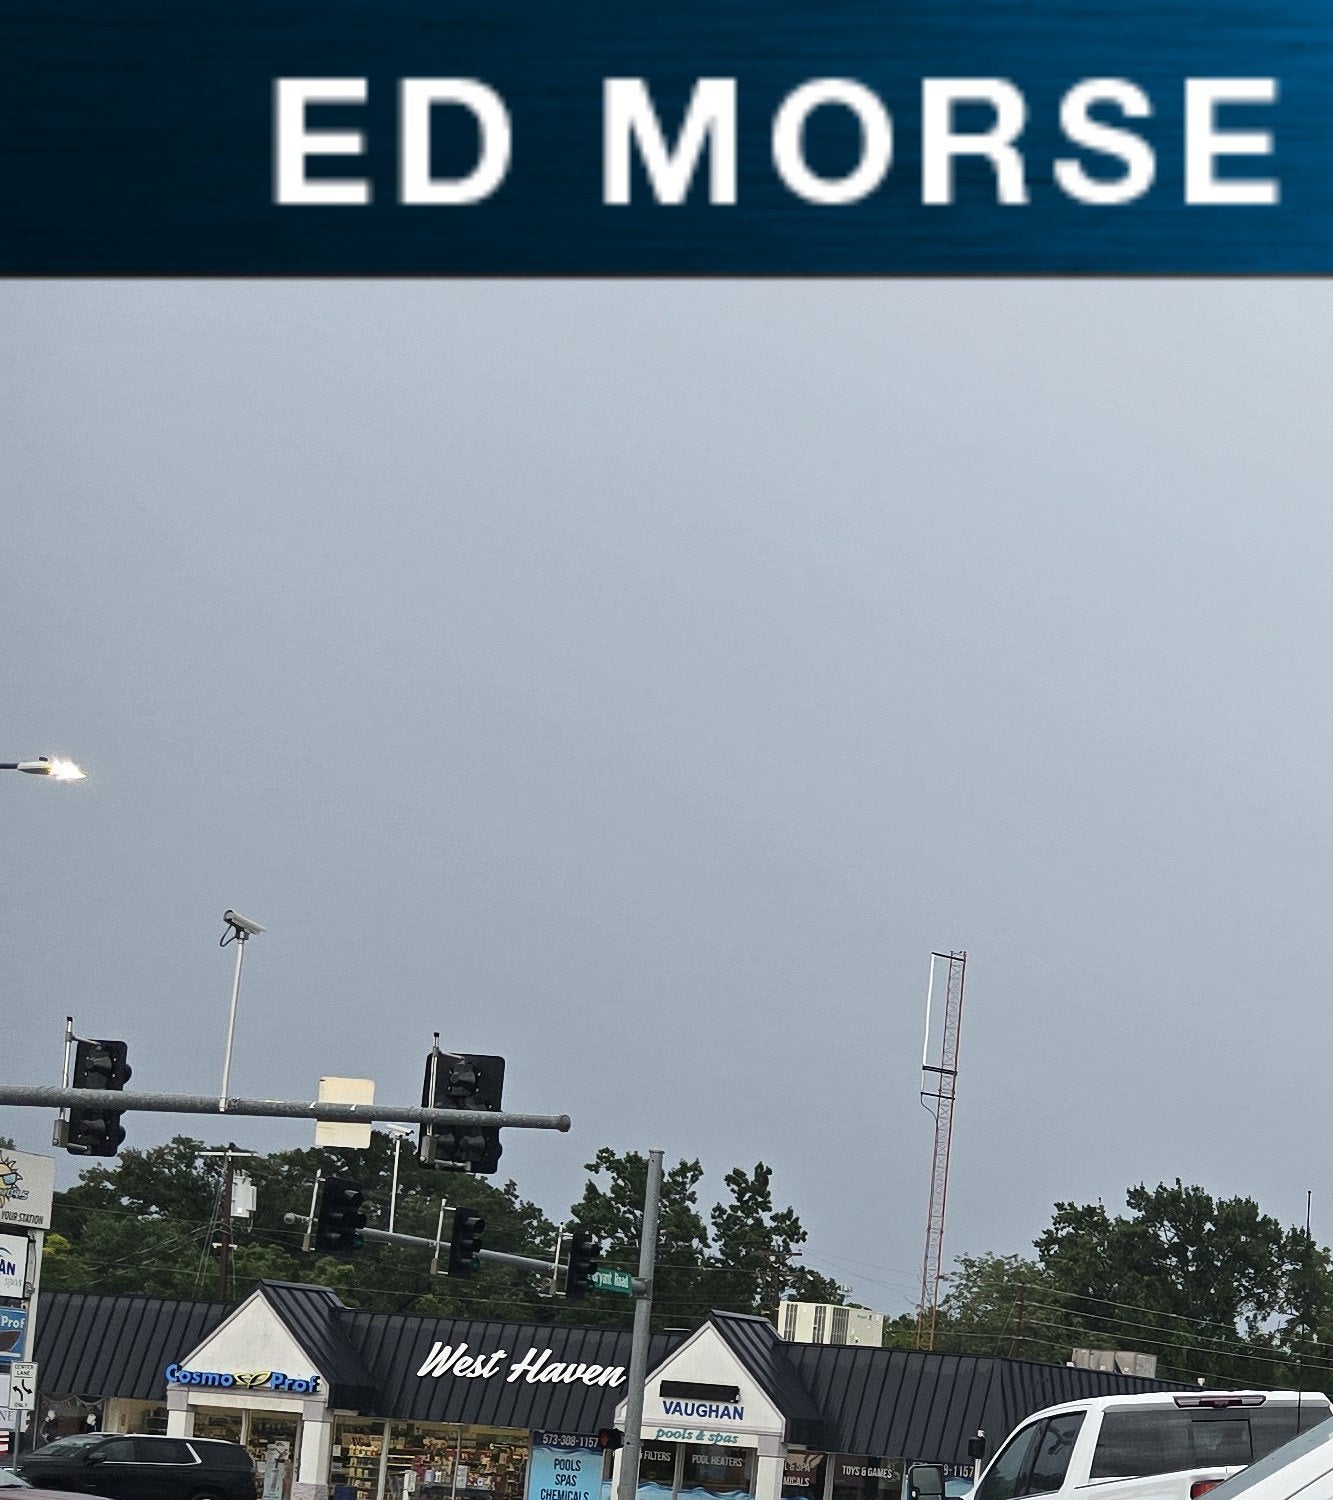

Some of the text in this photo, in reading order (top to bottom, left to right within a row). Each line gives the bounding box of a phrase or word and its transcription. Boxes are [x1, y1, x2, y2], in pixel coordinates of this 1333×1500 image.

[18, 1212, 44, 1224] STATION
[1, 1315, 26, 1329] Prof
[417, 1341, 627, 1388] West Haven
[166, 1363, 321, 1394] Cosmo Prof
[663, 1400, 745, 1421] VAUGHAN
[543, 1433, 599, 1448] 573-308-1157
[655, 1428, 739, 1445] pools & spas
[643, 1450, 671, 1462] FILTERS
[692, 1454, 744, 1468] POOL HEATERS
[554, 1458, 582, 1472] POOLS
[842, 1465, 861, 1476] TOYS
[867, 1466, 893, 1479] GAMES
[555, 1473, 578, 1487] SPAS
[783, 1475, 811, 1487] MICALS
